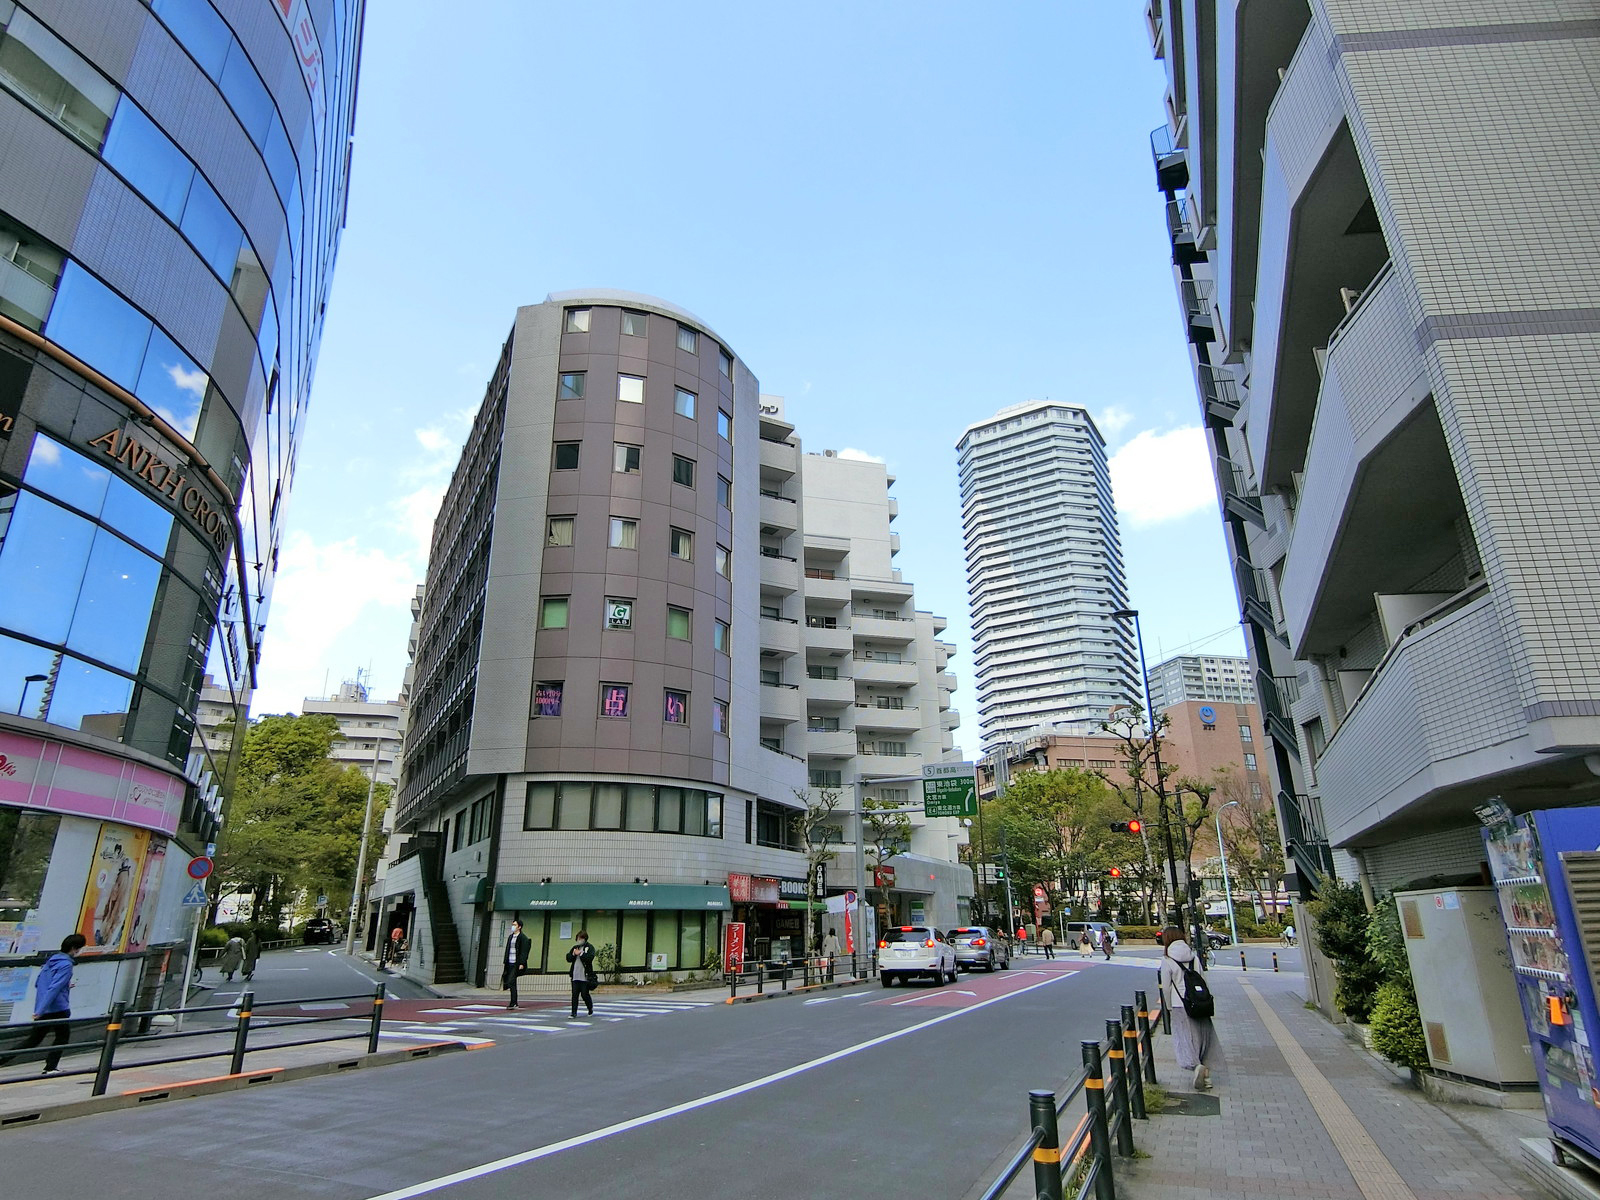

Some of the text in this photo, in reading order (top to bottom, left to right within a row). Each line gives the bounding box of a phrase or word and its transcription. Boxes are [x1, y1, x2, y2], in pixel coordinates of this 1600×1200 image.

[89, 428, 230, 552] ANKH CROSS
[779, 882, 807, 893] -BOOKS
